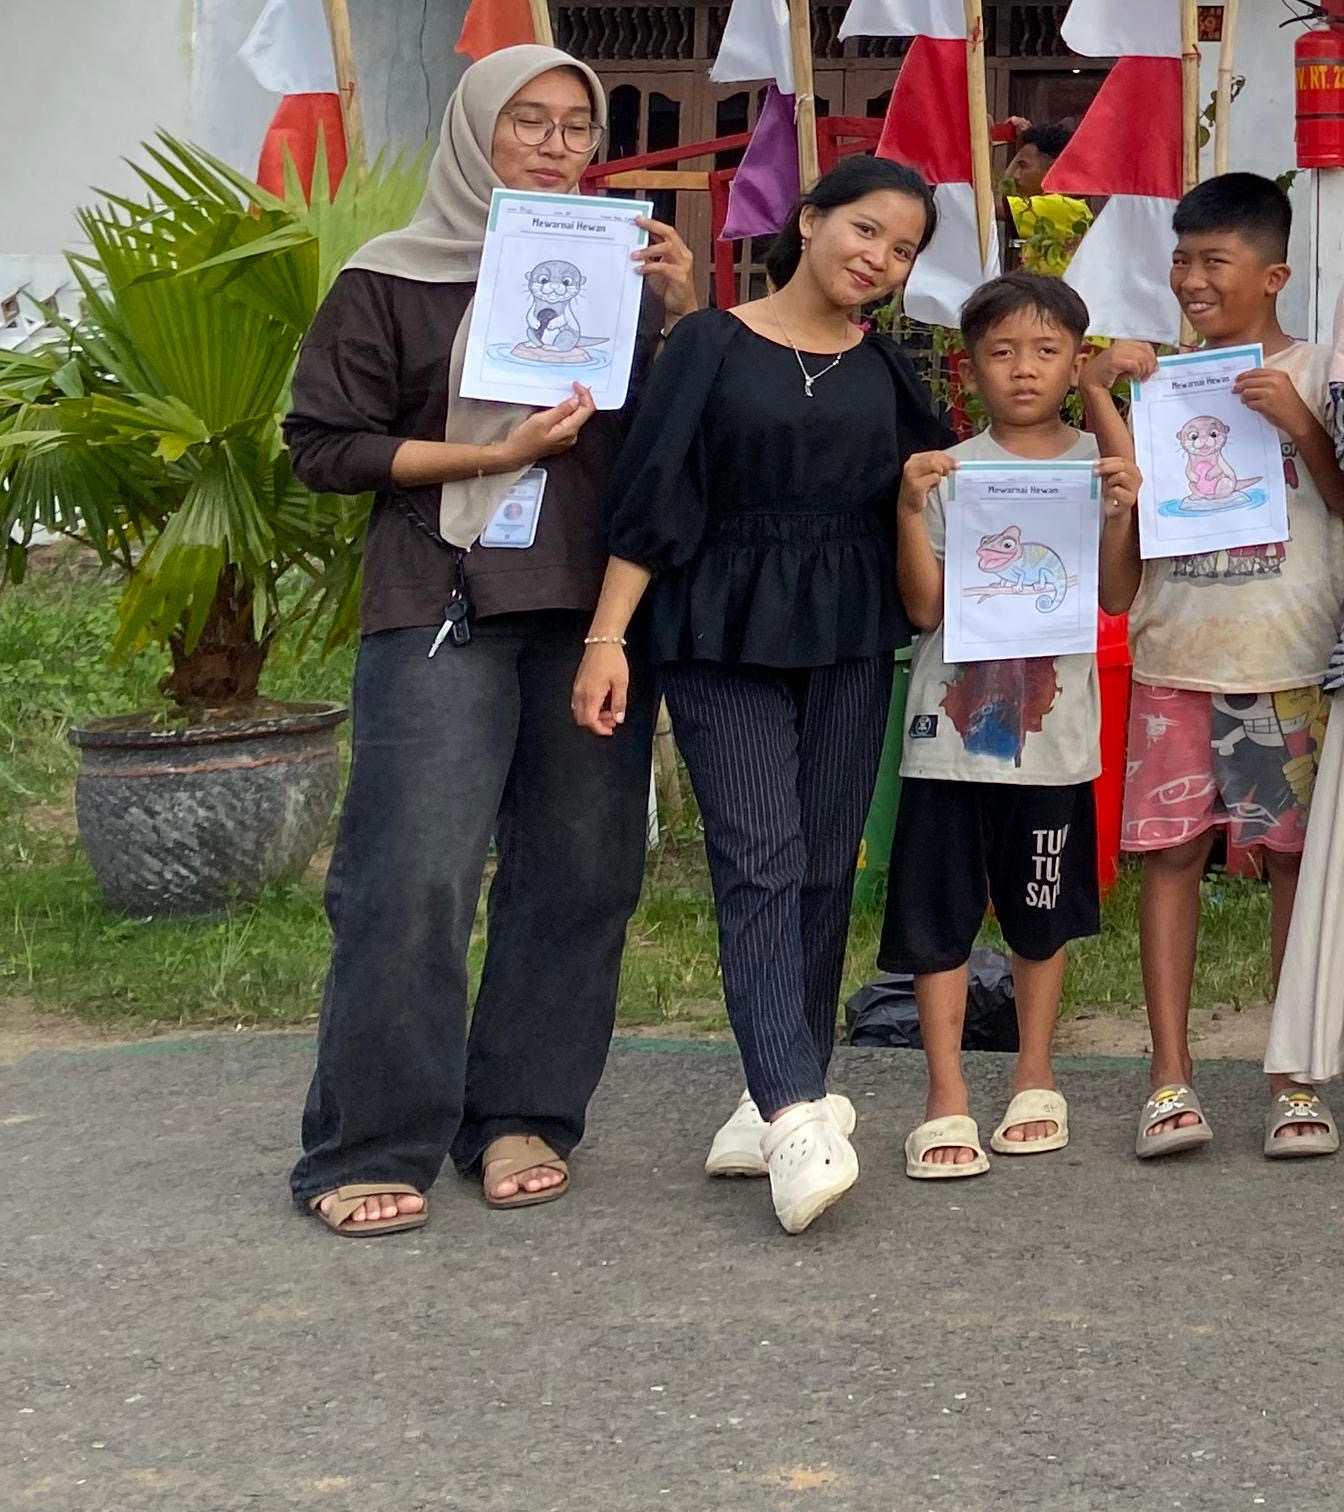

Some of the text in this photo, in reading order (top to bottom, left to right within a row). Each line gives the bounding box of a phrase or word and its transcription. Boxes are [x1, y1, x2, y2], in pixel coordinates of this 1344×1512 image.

[532, 217, 606, 233] Mewarnai Hewan
[1172, 375, 1230, 390] Mewarnai Hewan
[988, 485, 1059, 495] Mewarnai Hewan
[1032, 825, 1067, 854] TU
[1031, 856, 1060, 883] TU
